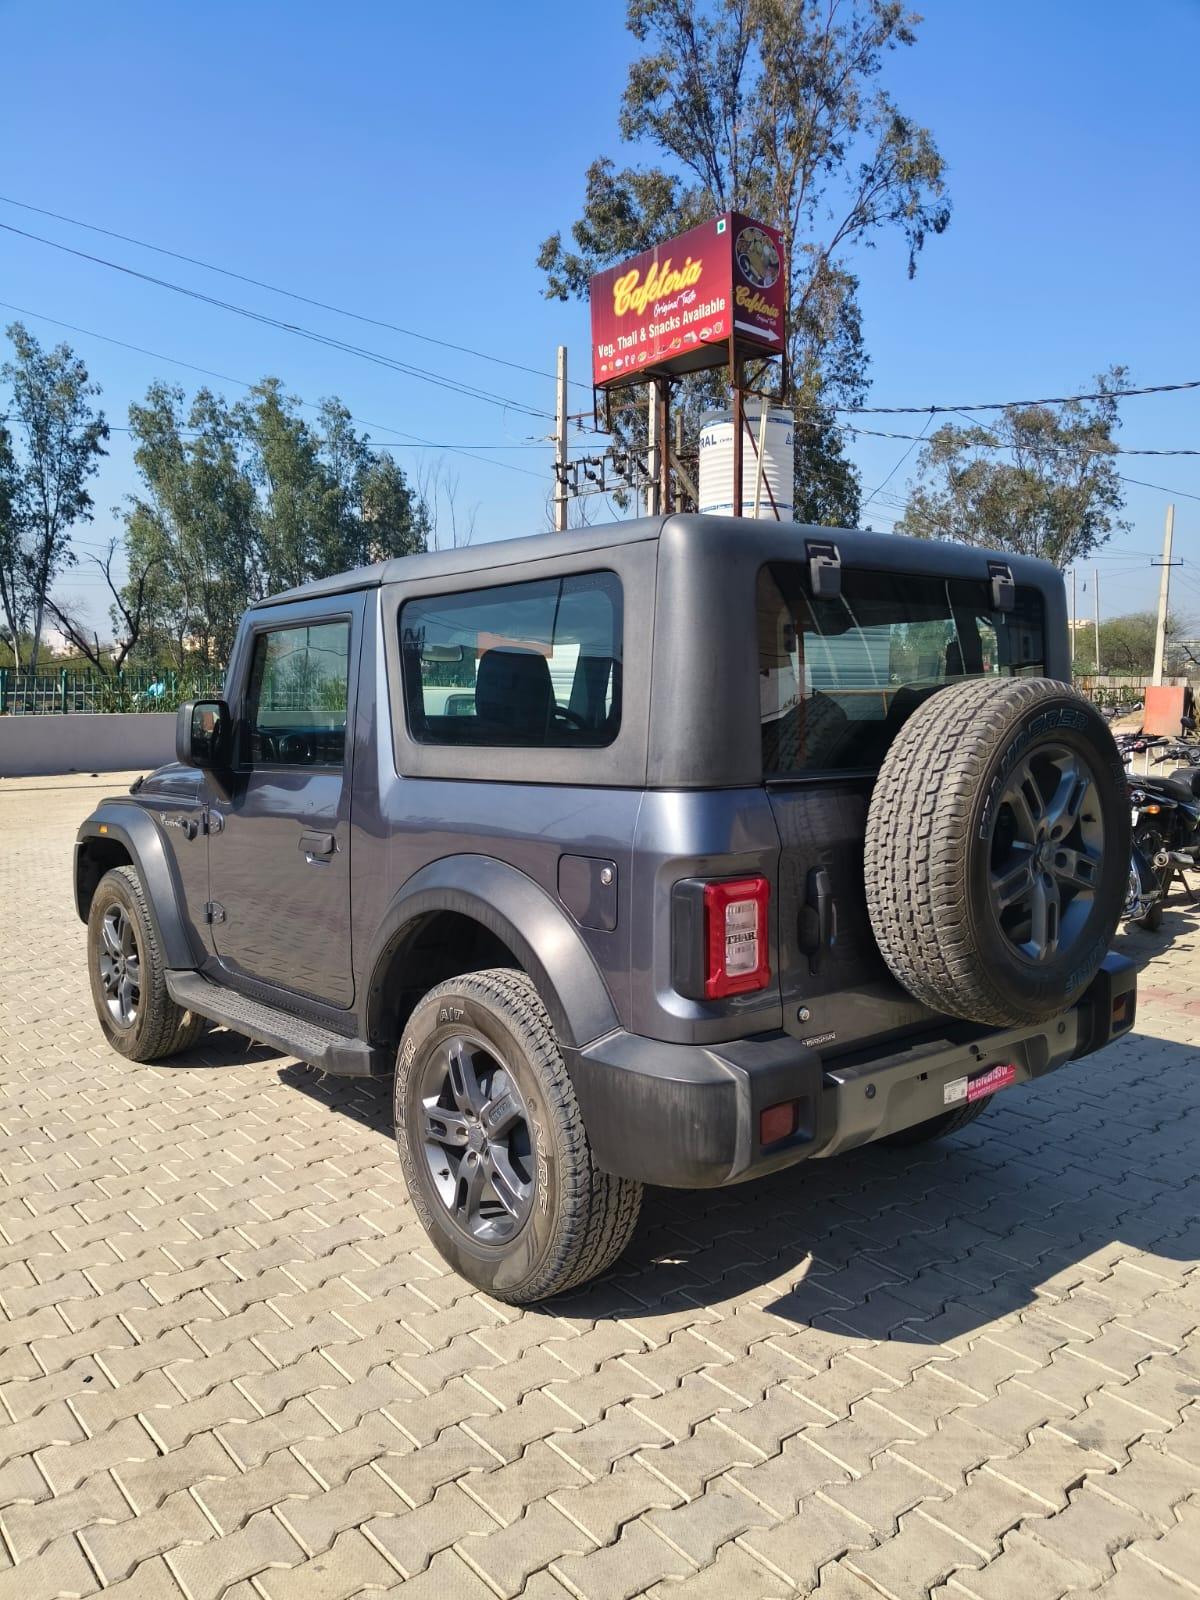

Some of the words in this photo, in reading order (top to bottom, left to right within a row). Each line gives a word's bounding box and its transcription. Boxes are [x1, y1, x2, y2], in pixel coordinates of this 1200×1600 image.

[614, 257, 703, 316] Cafeteria
[736, 286, 780, 318] Cafeteria
[598, 344, 615, 358] Veg.
[640, 327, 646, 342] &
[649, 316, 680, 338] Snacks
[683, 297, 725, 325] Available
[727, 931, 756, 945] THAR
